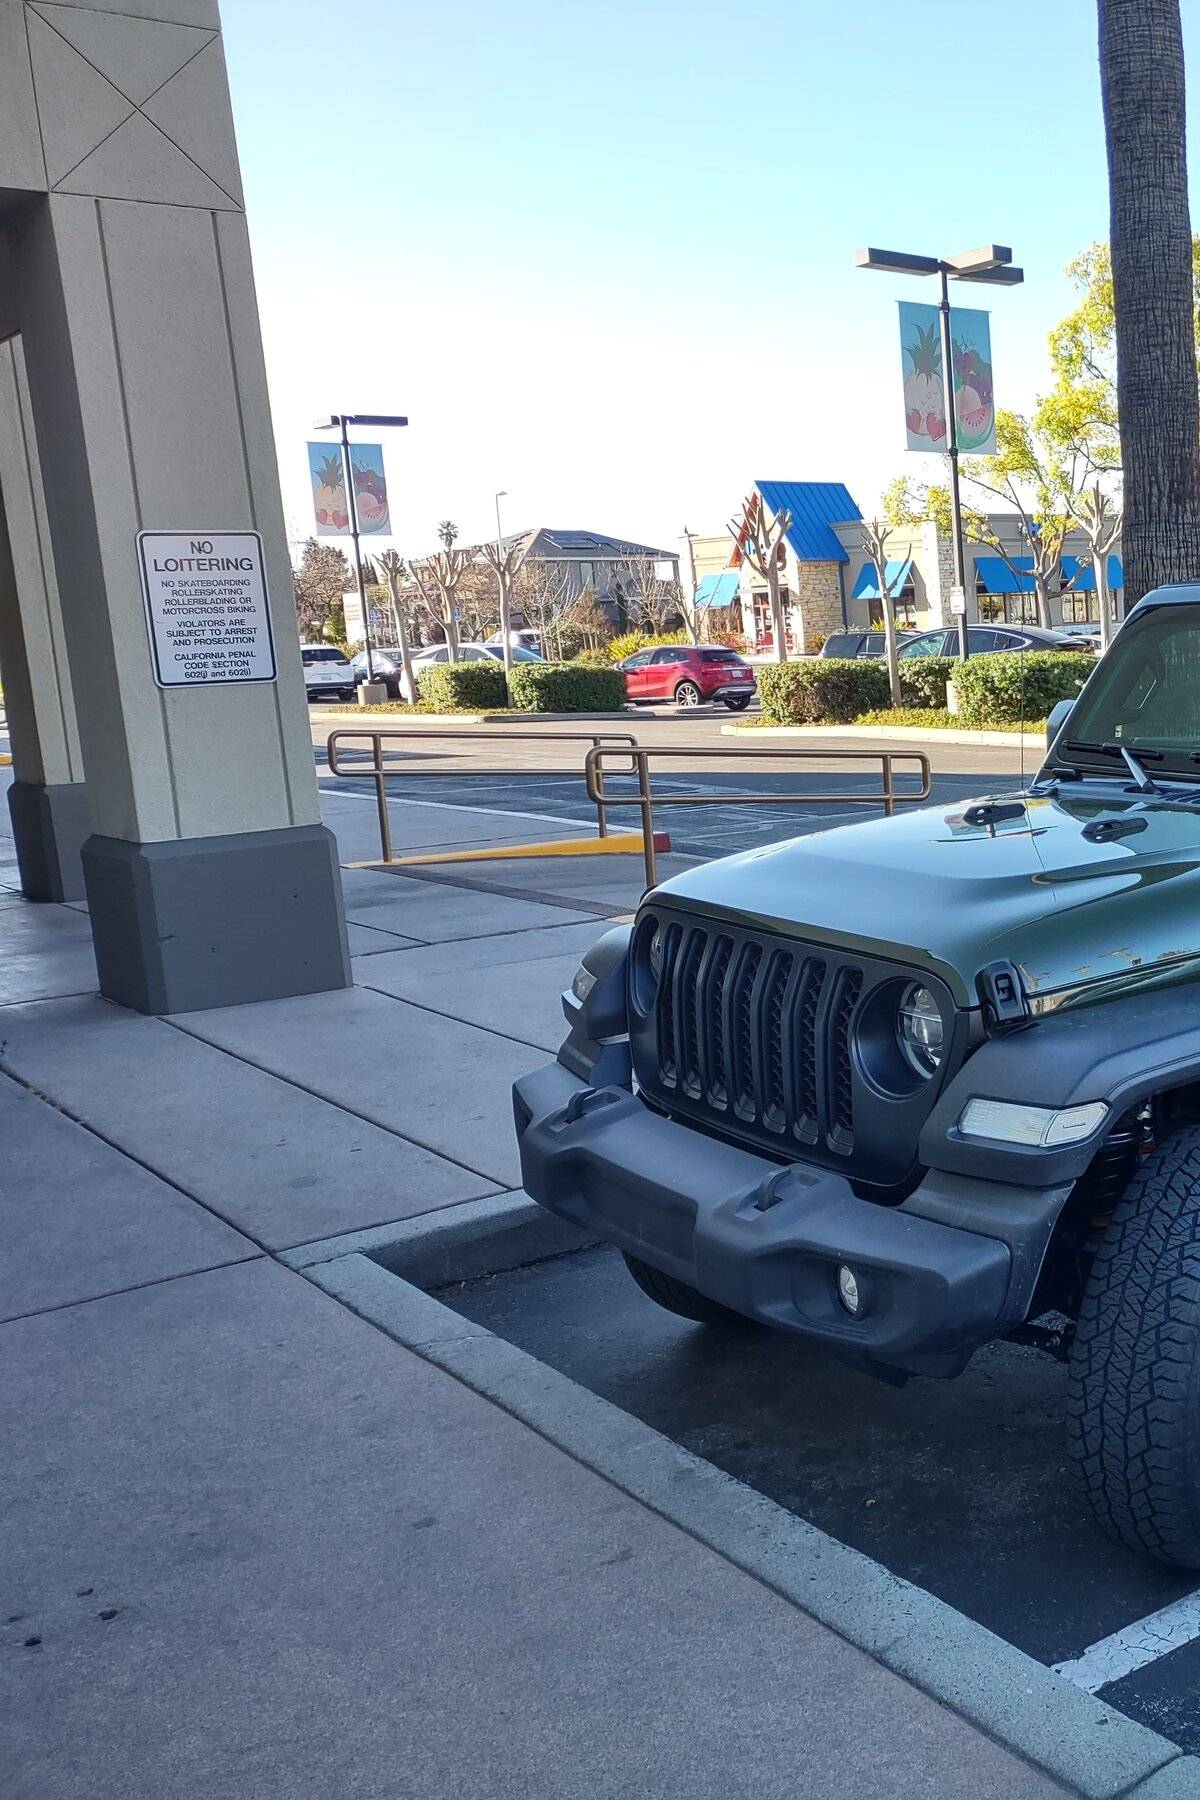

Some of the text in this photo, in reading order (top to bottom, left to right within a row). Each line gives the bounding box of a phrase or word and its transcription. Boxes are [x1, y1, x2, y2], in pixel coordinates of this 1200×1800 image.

[190, 541, 213, 554] NO
[153, 557, 254, 572] LOITERING
[161, 579, 251, 588] NO SKATEBOARDING
[172, 588, 243, 596] ROLLERSKATING
[165, 597, 237, 606] ROLLERBLADING
[162, 605, 256, 615] MOTORCROSS BIKING
[177, 619, 226, 628] VIOLATORS
[166, 627, 258, 638] SUBJECT TO ARREST
[172, 637, 255, 647] AND PROSECUTION
[174, 651, 256, 661] CALIFORNIA PENAL
[184, 660, 249, 670] CODE SECTION
[210, 669, 226, 677] and
